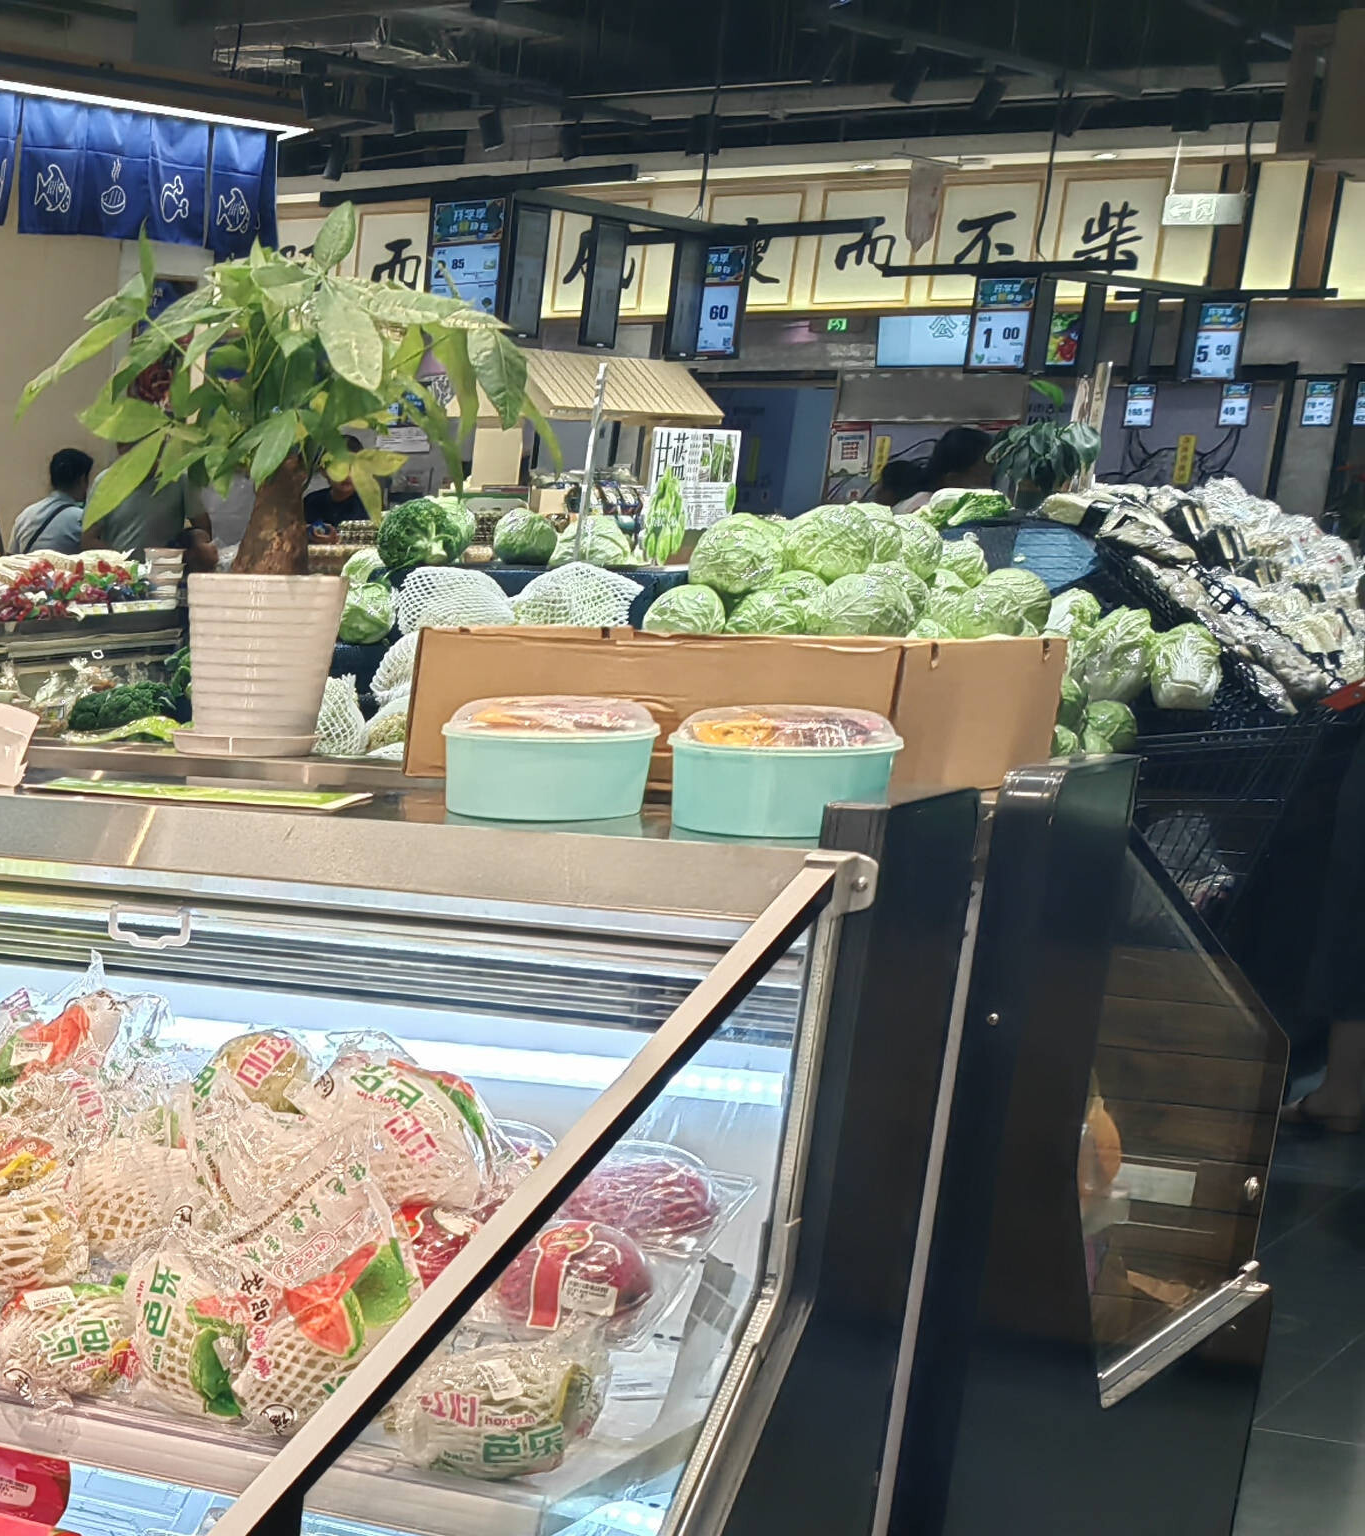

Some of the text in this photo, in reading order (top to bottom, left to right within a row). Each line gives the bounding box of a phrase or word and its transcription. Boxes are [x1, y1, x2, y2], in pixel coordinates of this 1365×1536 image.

[451, 257, 466, 269] 85
[708, 304, 730, 321] 60
[983, 326, 1020, 349] 1 00
[1196, 344, 1231, 363] 5 50
[482, 1422, 565, 1464] 芭乐
